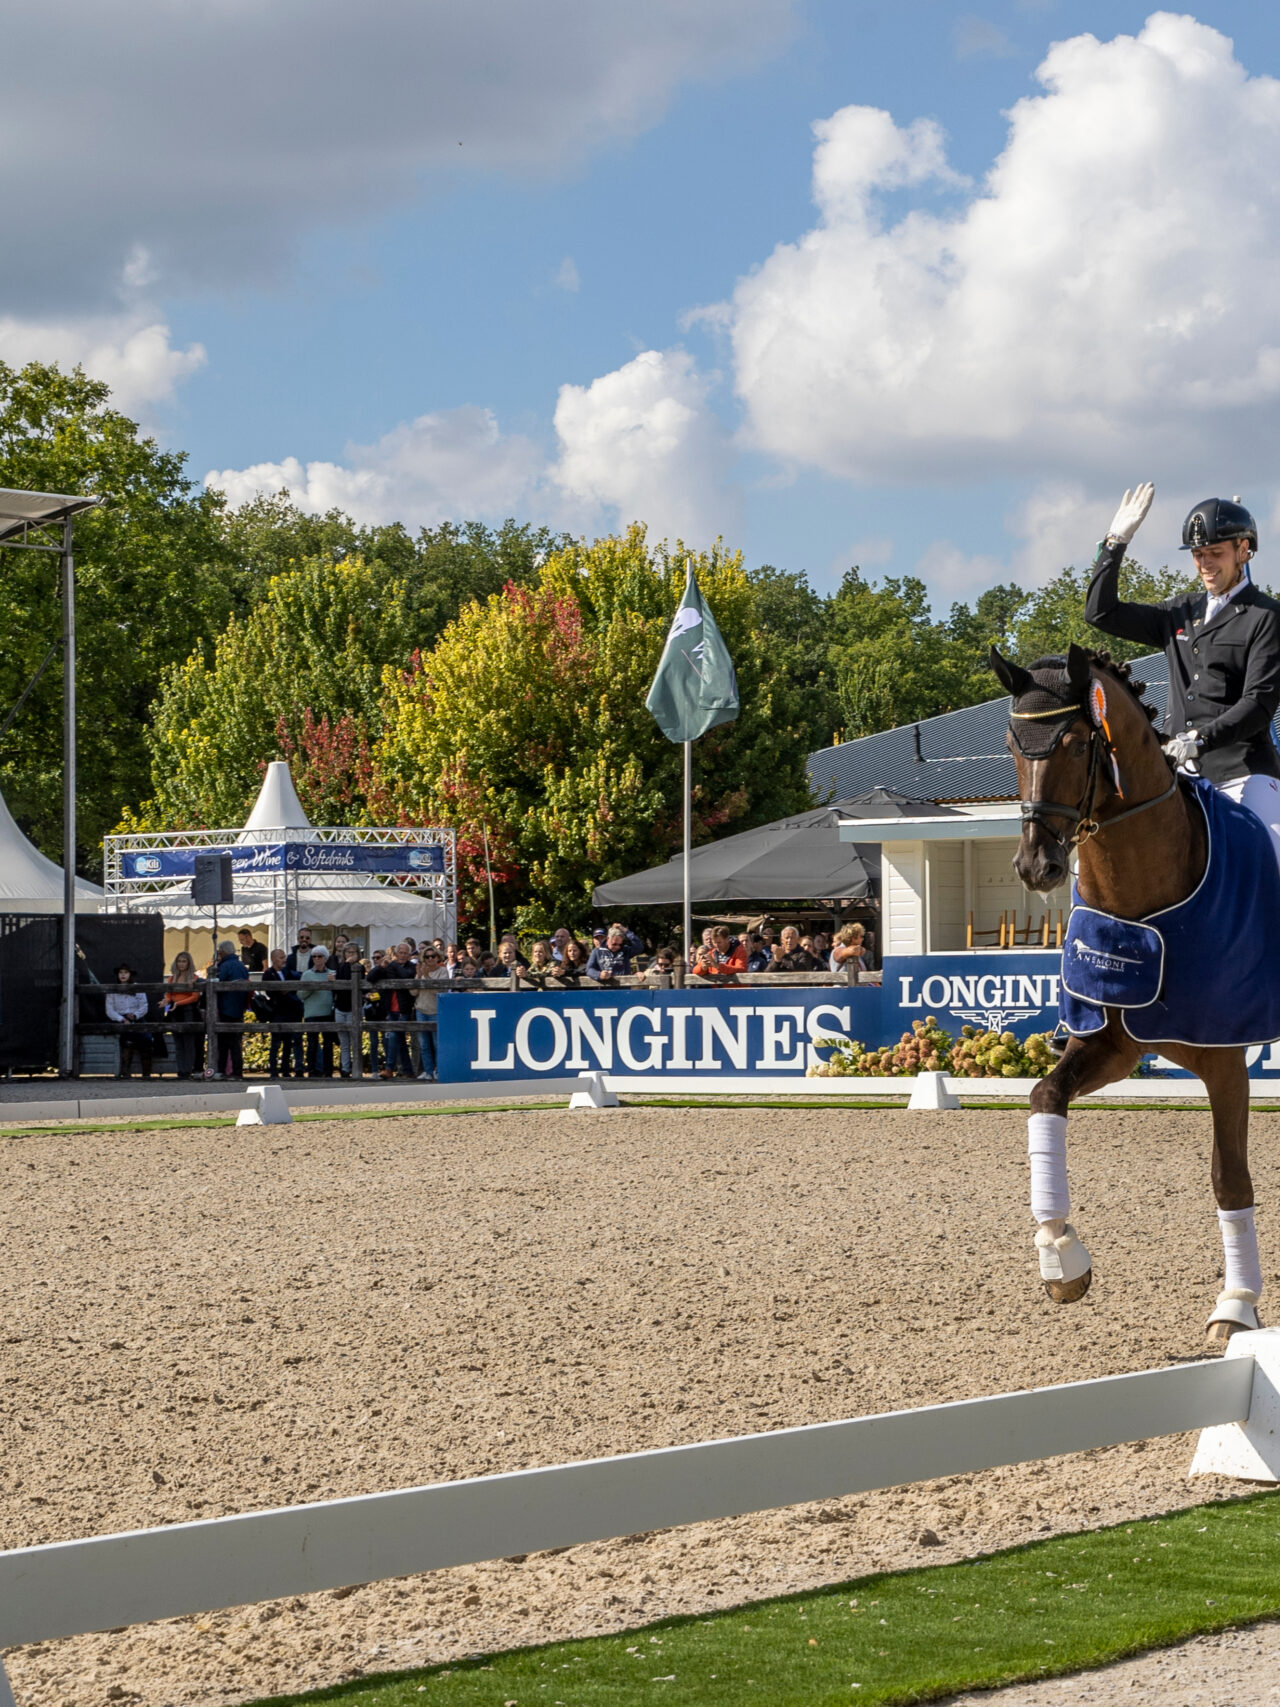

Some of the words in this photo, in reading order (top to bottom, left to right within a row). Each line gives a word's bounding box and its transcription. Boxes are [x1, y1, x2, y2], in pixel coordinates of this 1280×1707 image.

[251, 848, 282, 867] Wine
[286, 850, 299, 865] &
[302, 846, 355, 869] Softdrinks
[1076, 953, 1126, 970] ANEMONE
[899, 974, 1060, 1009] LONGINE
[470, 1005, 851, 1071] LONGINES
